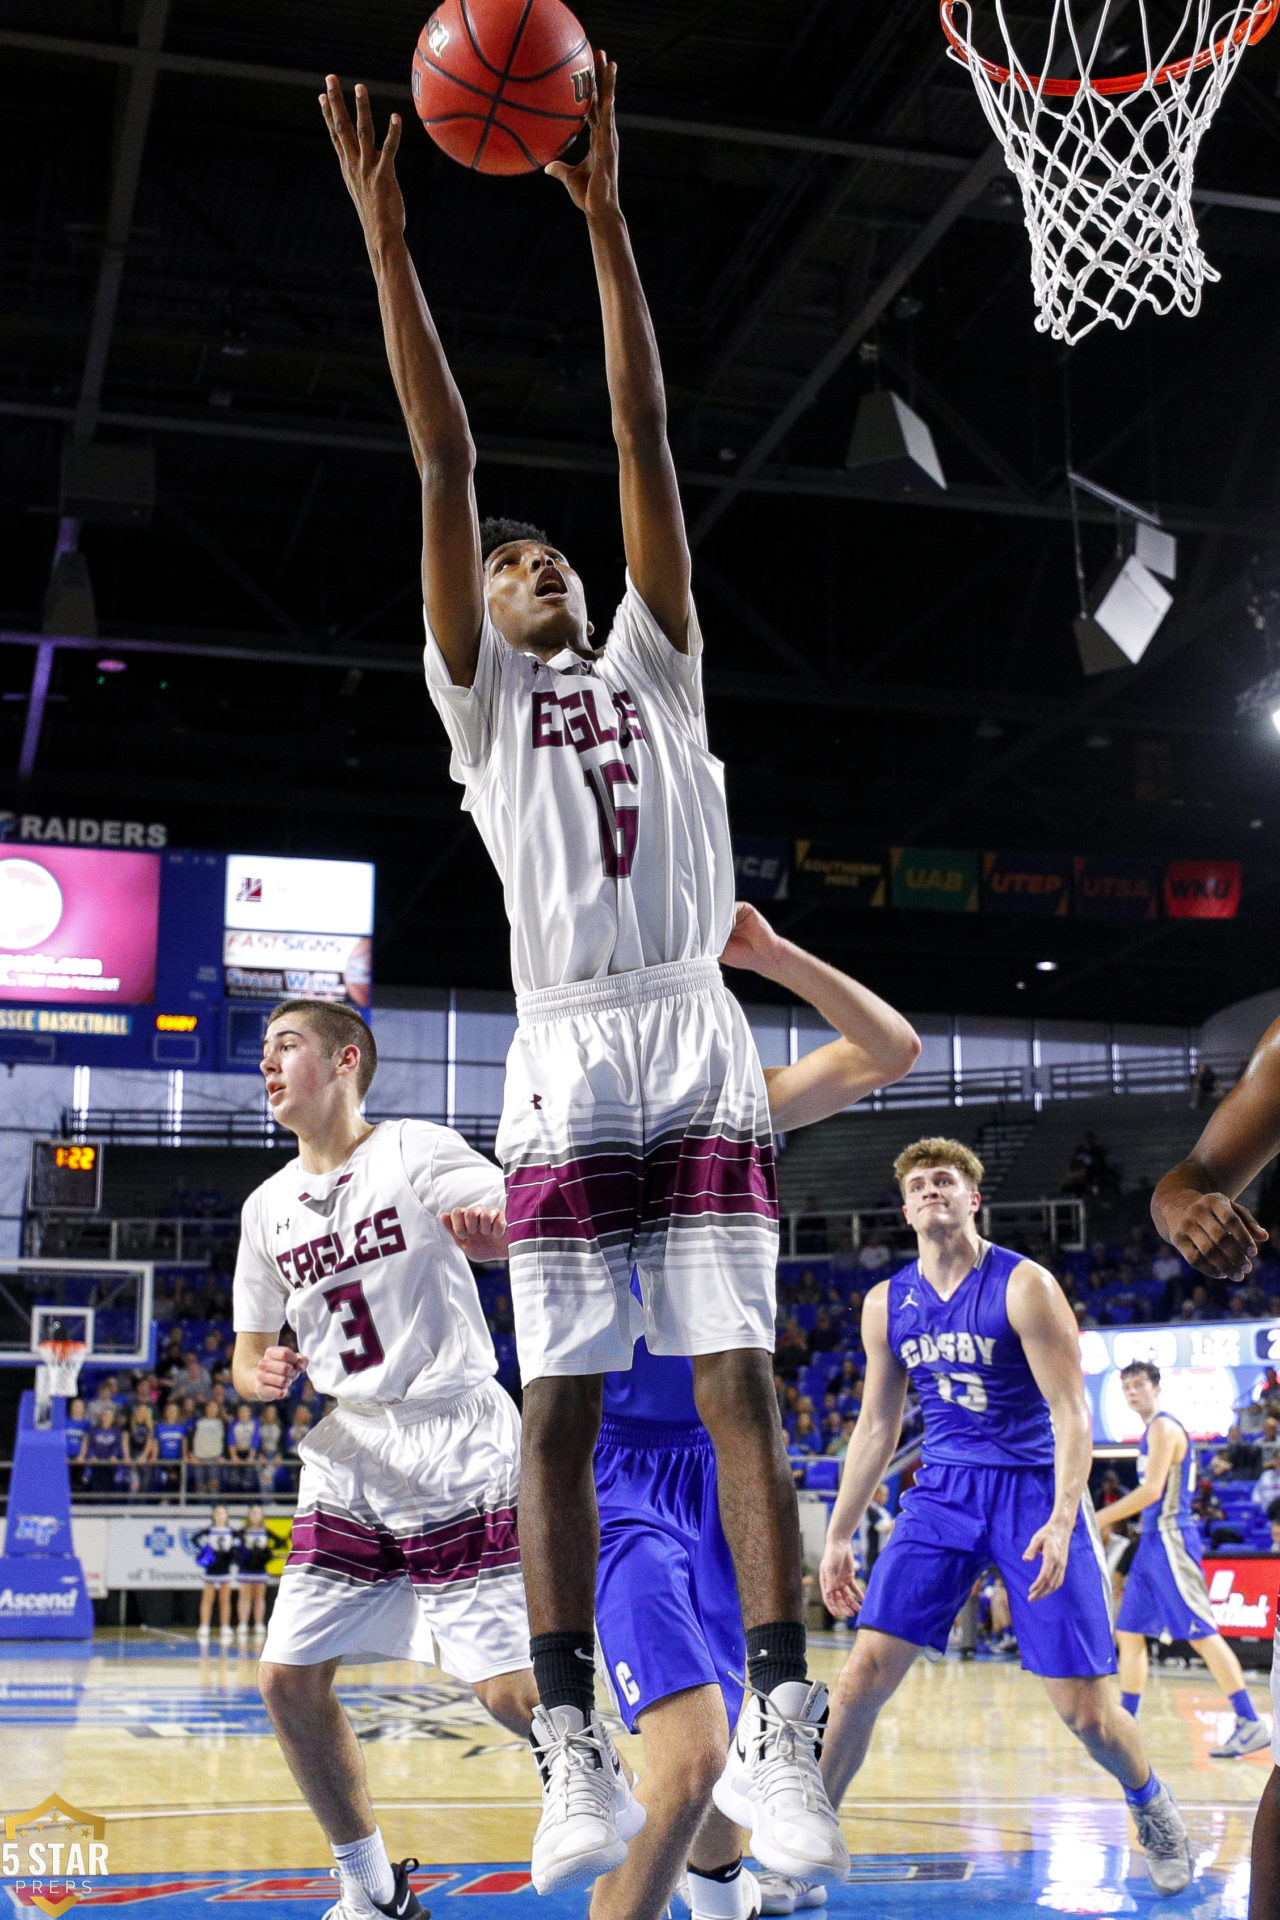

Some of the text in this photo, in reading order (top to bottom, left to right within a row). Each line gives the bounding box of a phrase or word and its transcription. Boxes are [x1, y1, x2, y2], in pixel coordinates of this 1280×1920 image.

[20, 815, 168, 848] RAIDERS
[906, 869, 964, 891] UAB
[38, 1011, 129, 1035] BASKETBALL
[56, 1146, 95, 1170] 1:22
[276, 1206, 407, 1289] EAGLES
[322, 1279, 385, 1375] 3
[901, 1332, 996, 1368] COSBY
[932, 1372, 988, 1412] 13
[0, 1588, 78, 1609] Ascend
